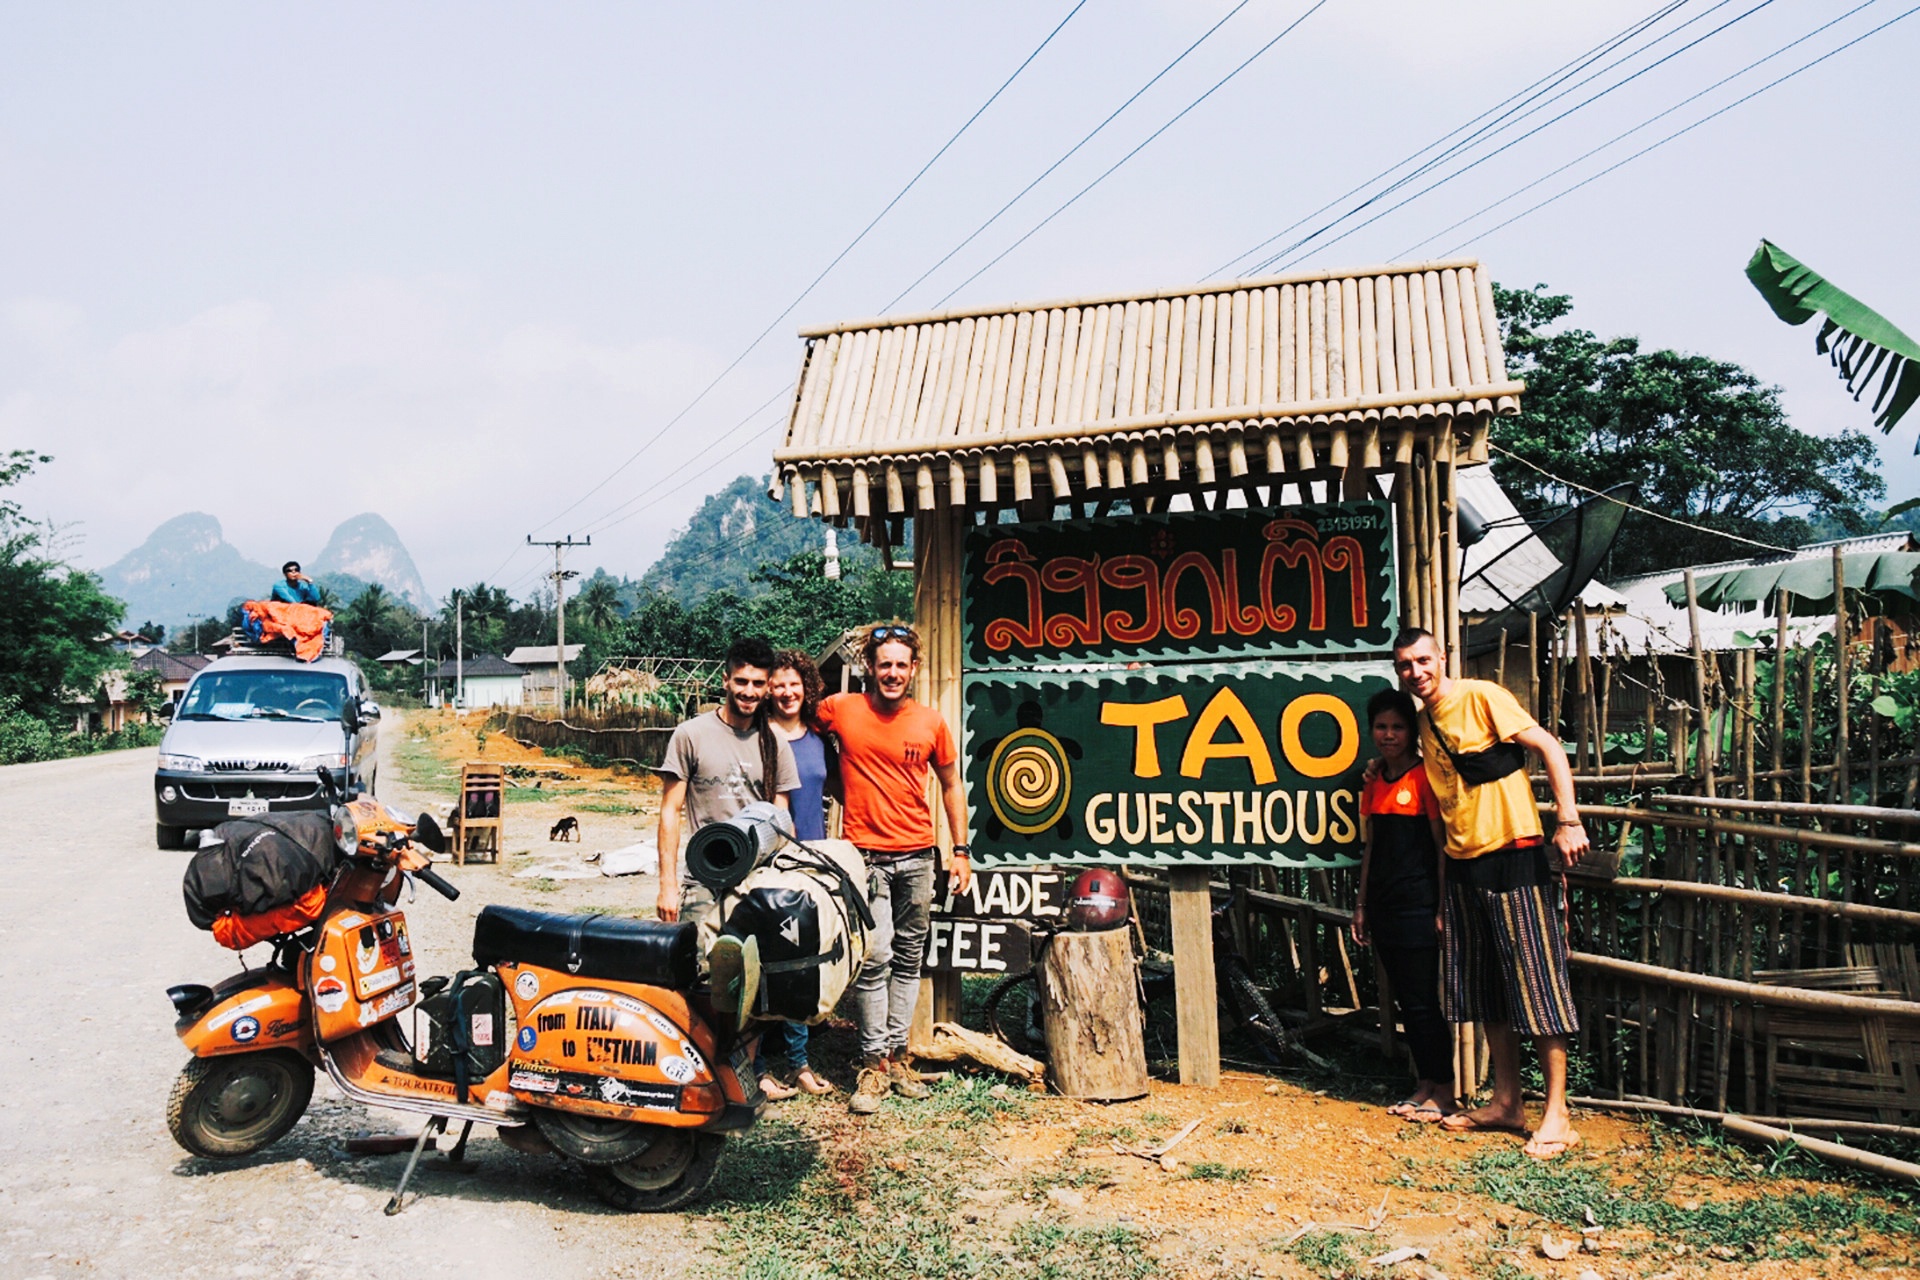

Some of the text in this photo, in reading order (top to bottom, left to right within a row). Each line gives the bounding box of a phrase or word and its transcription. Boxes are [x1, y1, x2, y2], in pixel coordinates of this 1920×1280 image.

[1317, 515, 1377, 532] 23131951
[1100, 685, 1360, 786] TAO
[1085, 789, 1367, 845] GUESTHOUS
[537, 1013, 566, 1033] from
[576, 1006, 620, 1032] ITALY
[562, 1038, 576, 1057] to
[393, 1076, 457, 1095] TOURATECH
